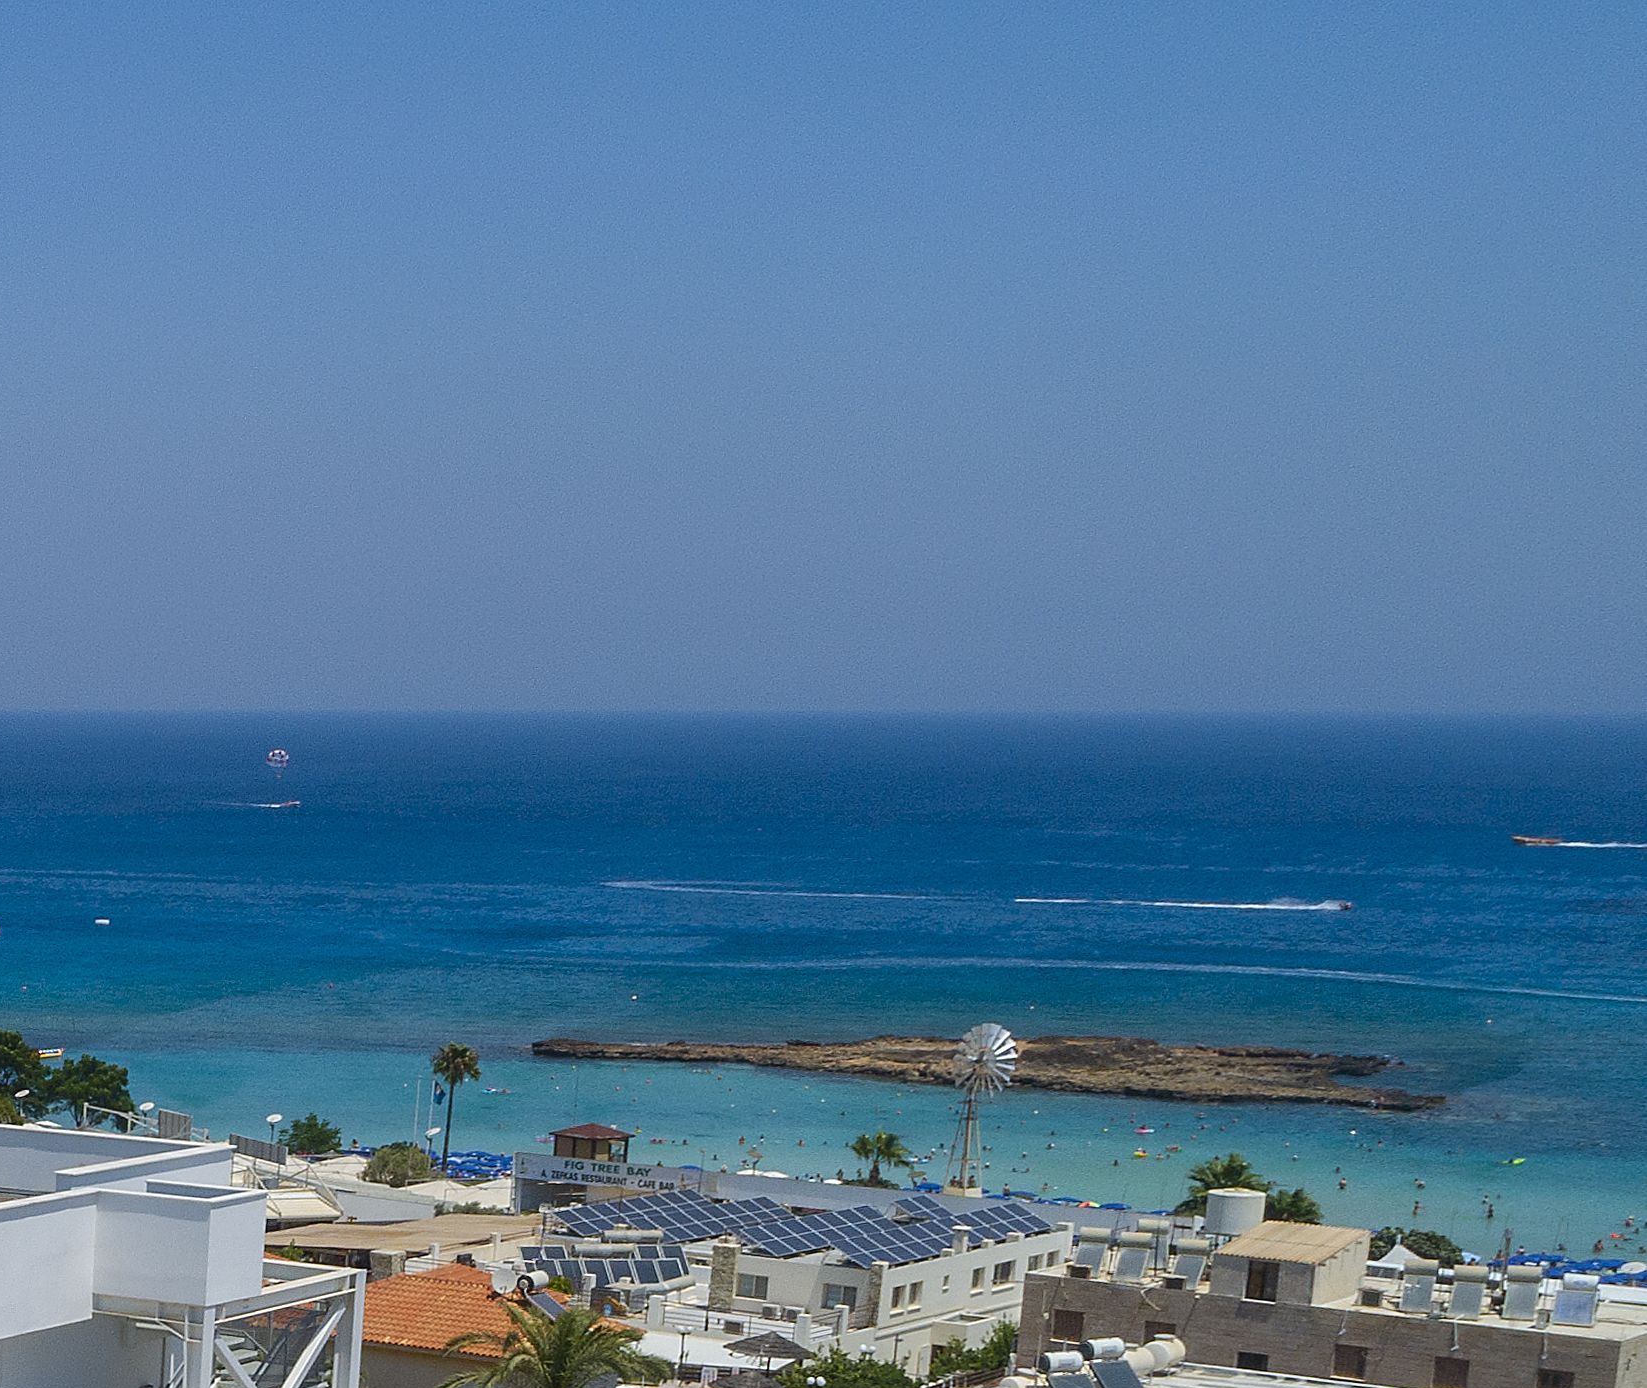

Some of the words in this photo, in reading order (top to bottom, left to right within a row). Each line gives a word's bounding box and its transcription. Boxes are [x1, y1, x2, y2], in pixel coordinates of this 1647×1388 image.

[564, 1160, 584, 1171] FIG
[591, 1162, 620, 1174] TREE
[627, 1166, 652, 1177] BAY
[581, 1173, 627, 1186] RESTAURANT
